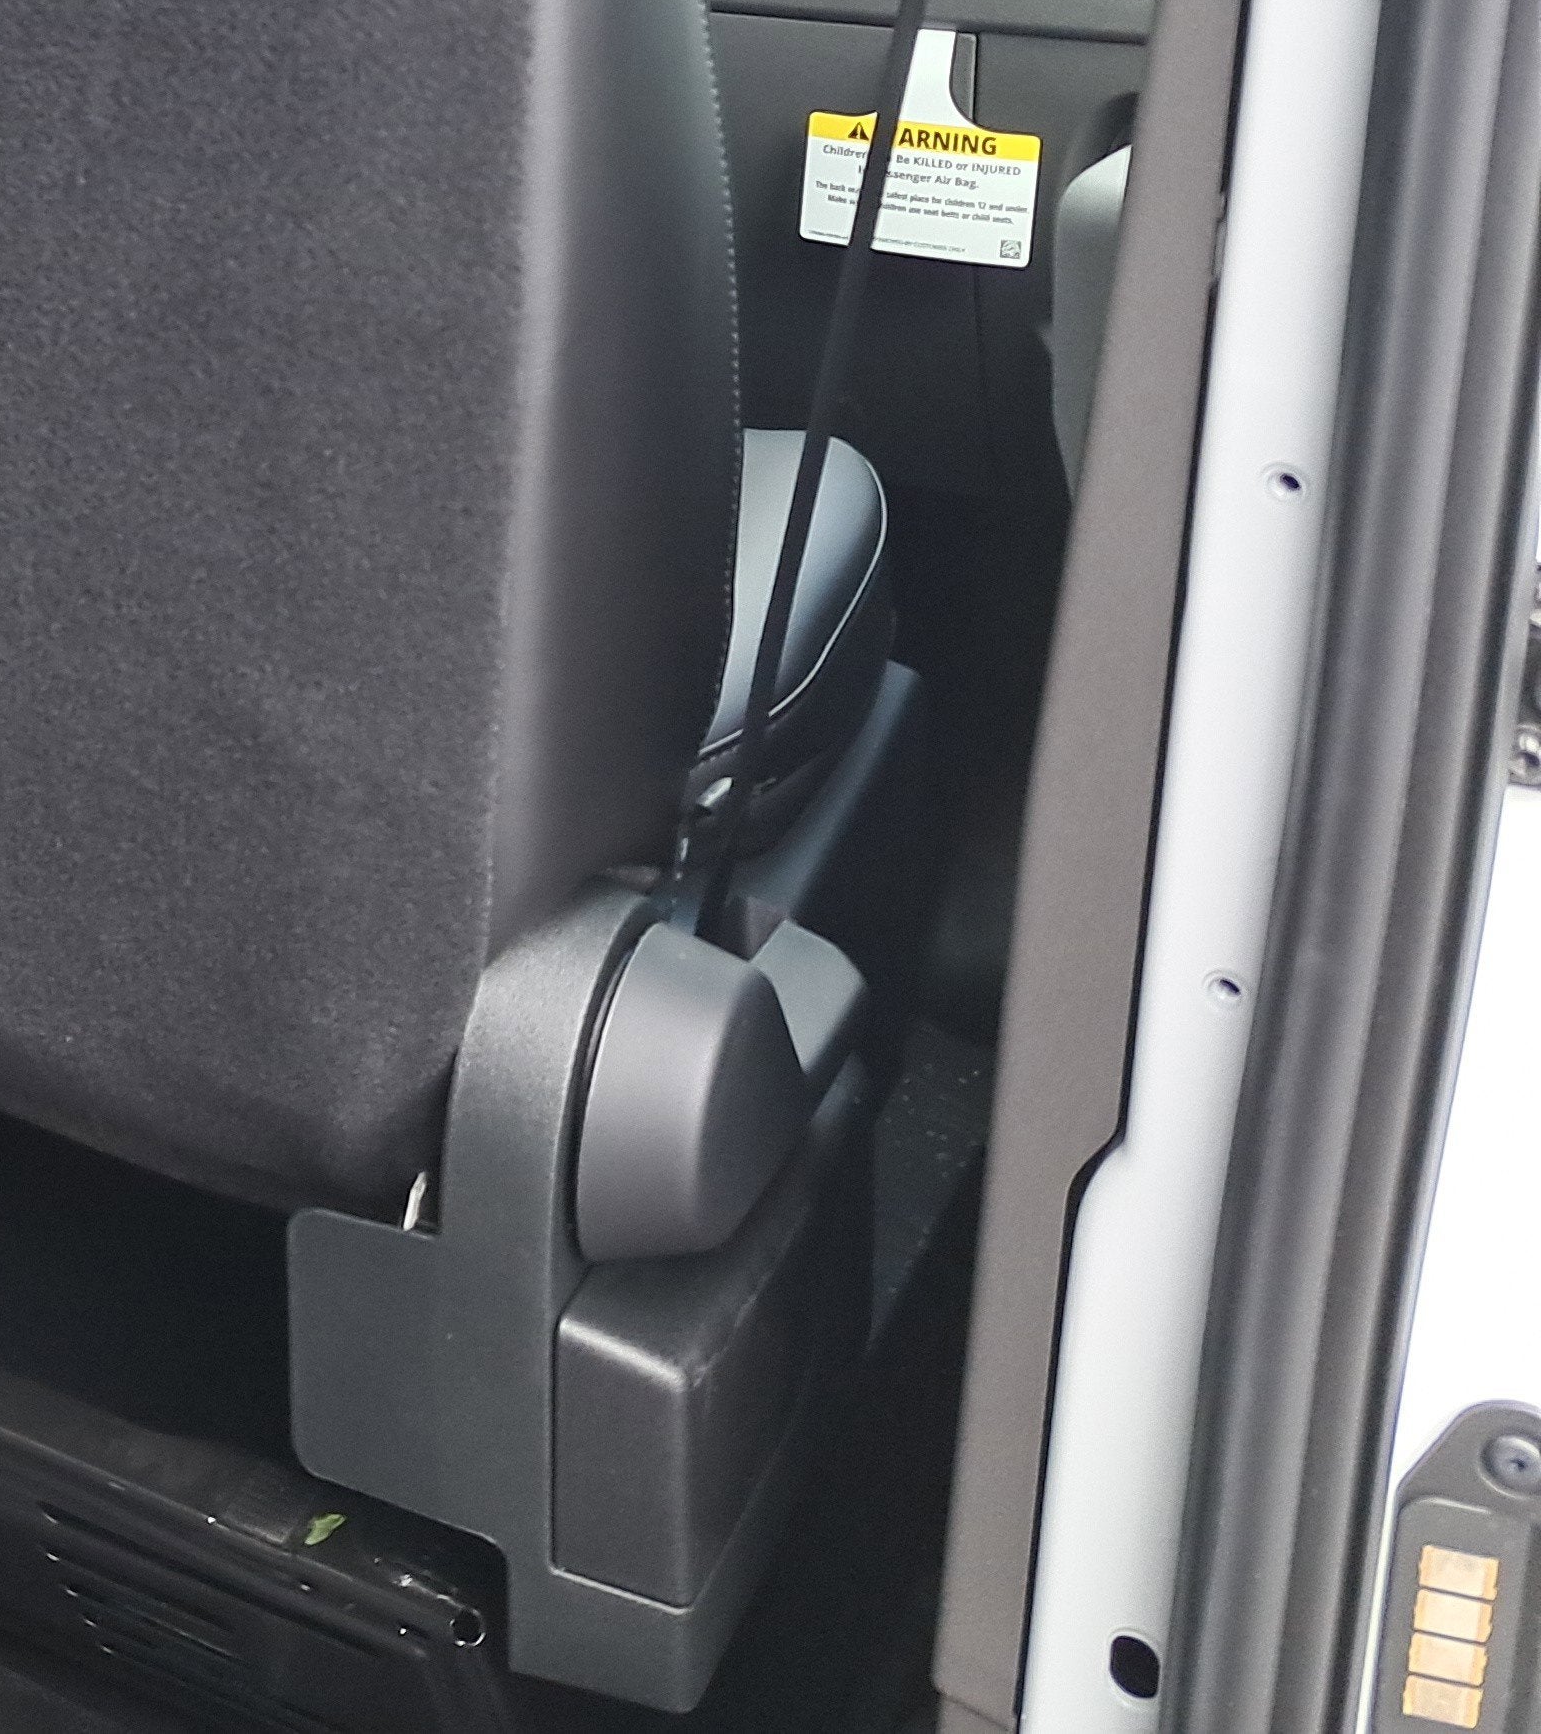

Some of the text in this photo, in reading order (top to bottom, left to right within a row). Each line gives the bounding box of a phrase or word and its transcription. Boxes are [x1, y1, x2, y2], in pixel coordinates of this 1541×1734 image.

[898, 127, 997, 156] ARNING
[913, 156, 953, 170] KILLED
[971, 163, 1022, 176] INJURED
